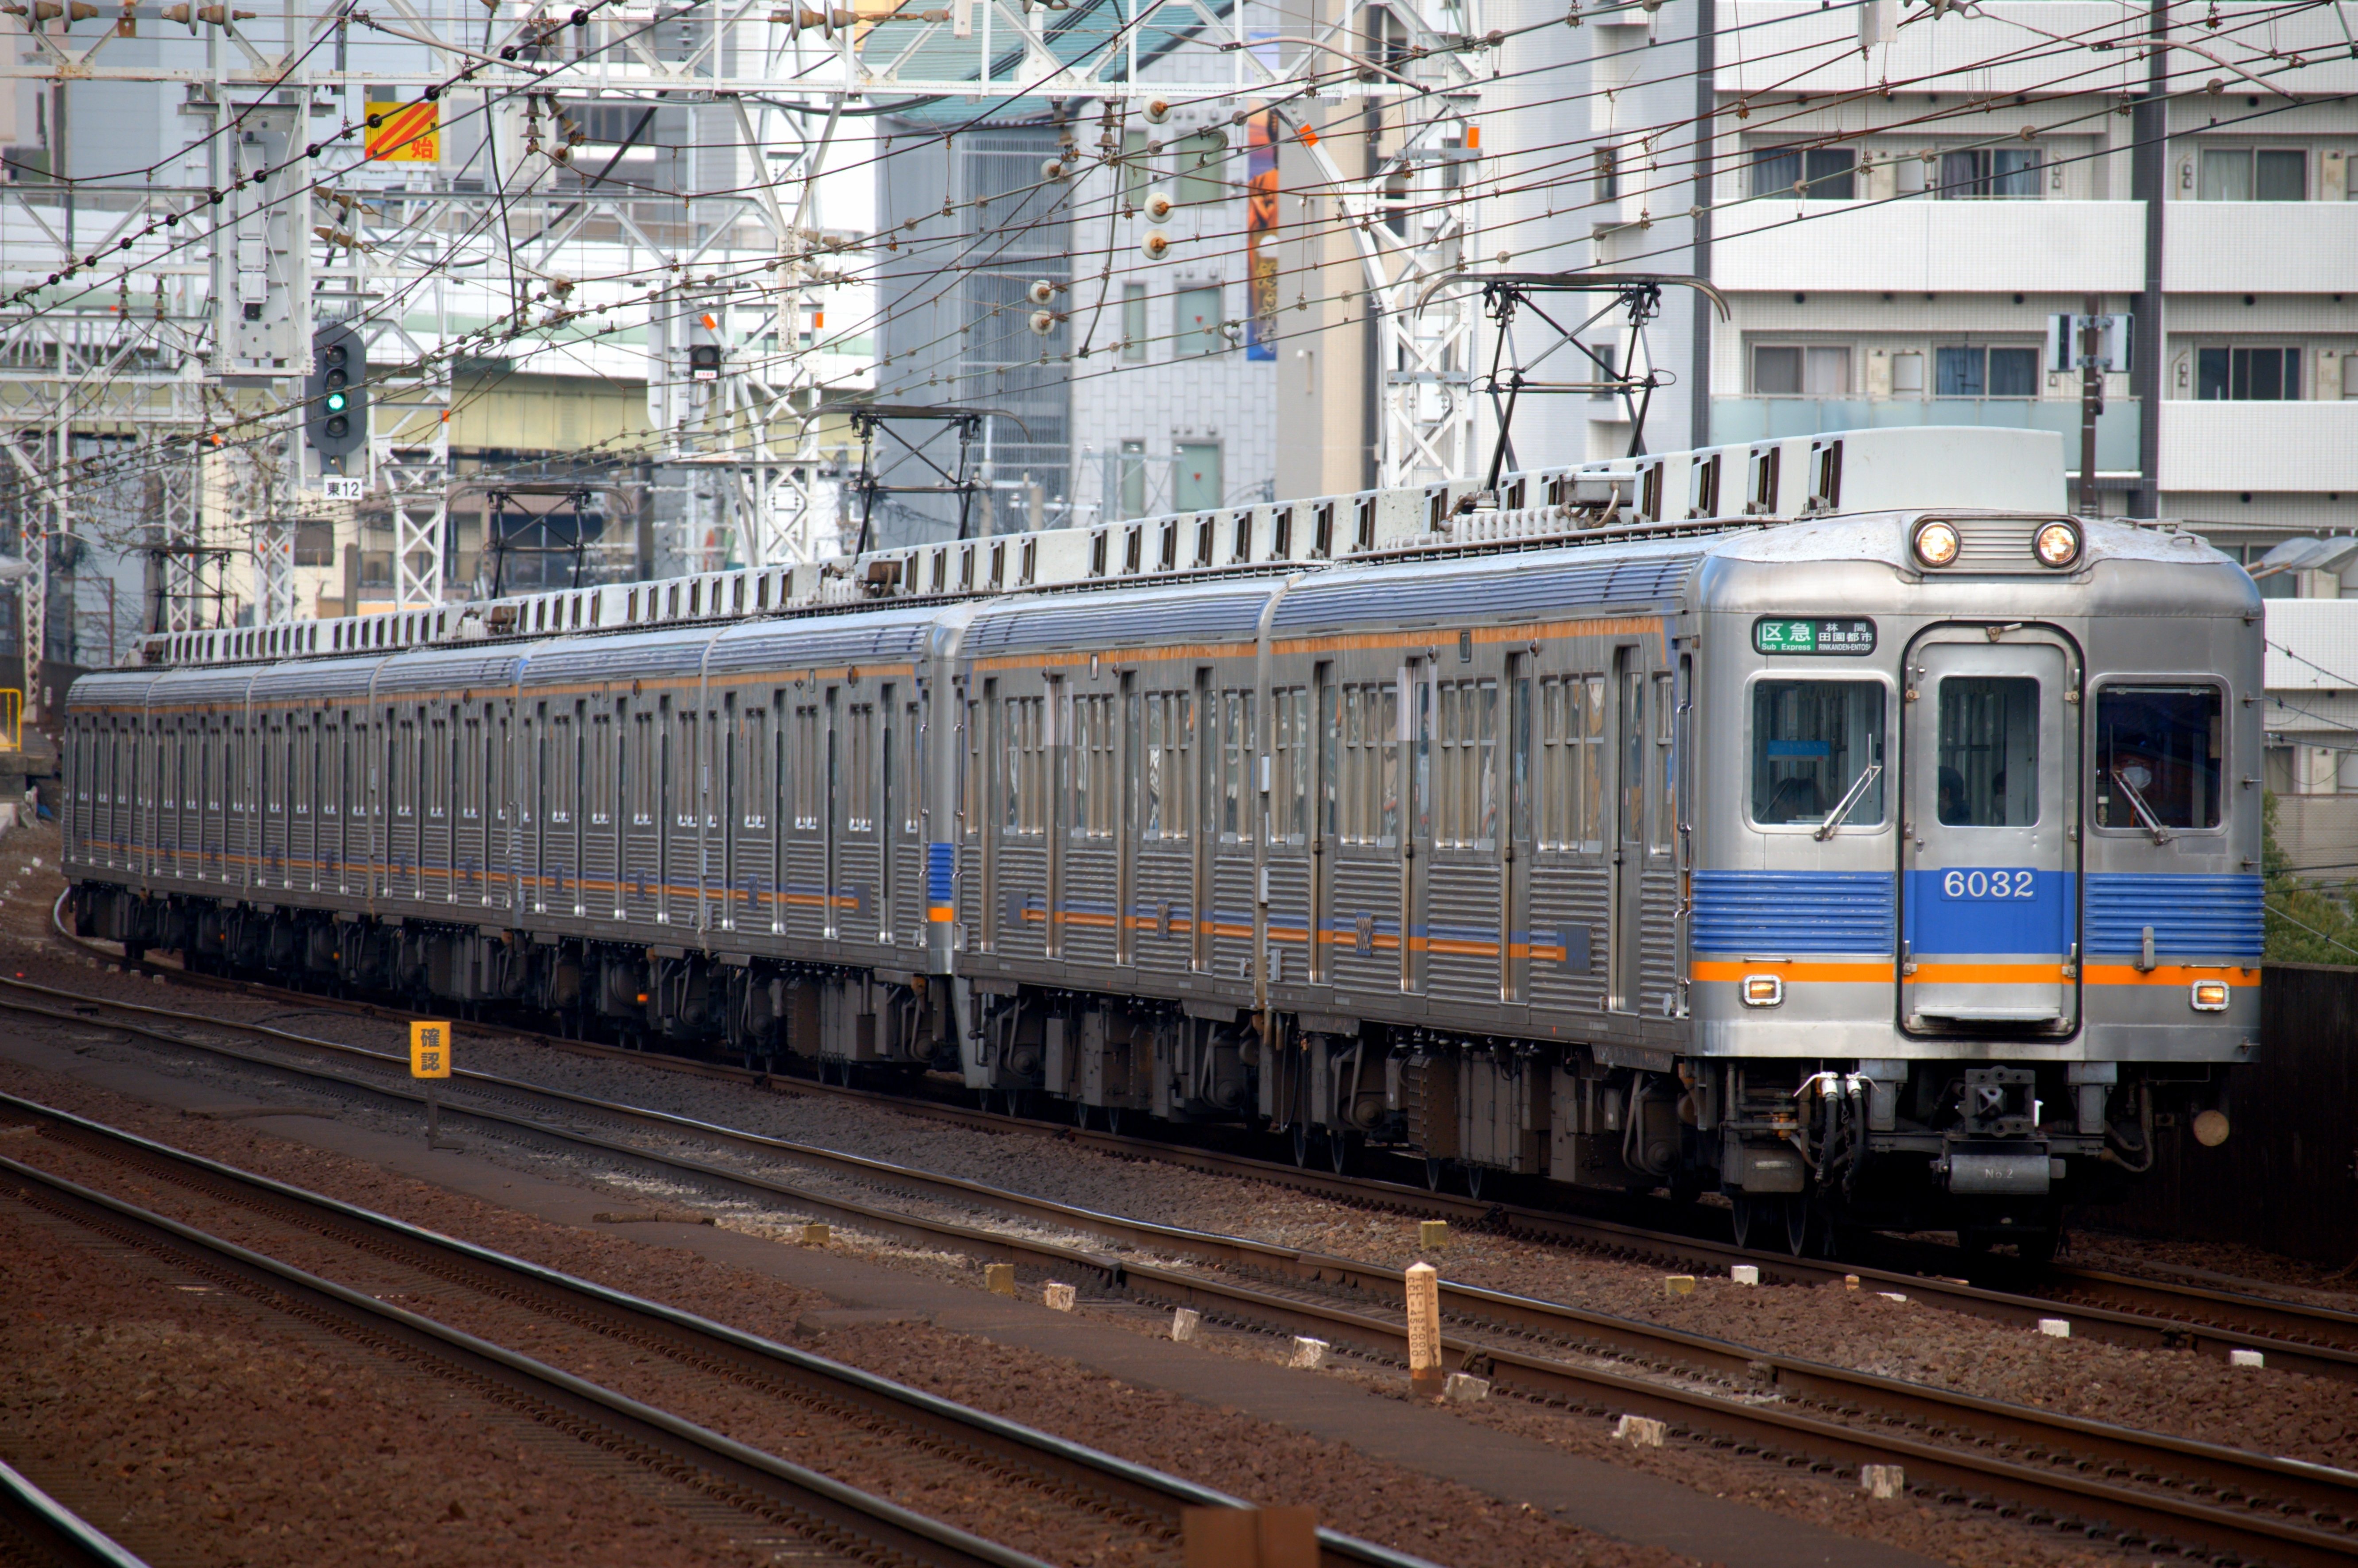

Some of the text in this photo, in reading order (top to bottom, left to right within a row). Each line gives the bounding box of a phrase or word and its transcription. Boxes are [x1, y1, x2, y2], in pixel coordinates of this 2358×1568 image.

[411, 136, 434, 159] 始
[327, 481, 359, 496] 東12
[1762, 623, 1811, 642] 区急
[1826, 623, 1866, 633] 林間
[1819, 632, 1873, 643] 田園都市
[1781, 643, 1811, 651] Express
[1944, 871, 2034, 898] 6032
[420, 1028, 440, 1071] 確認
